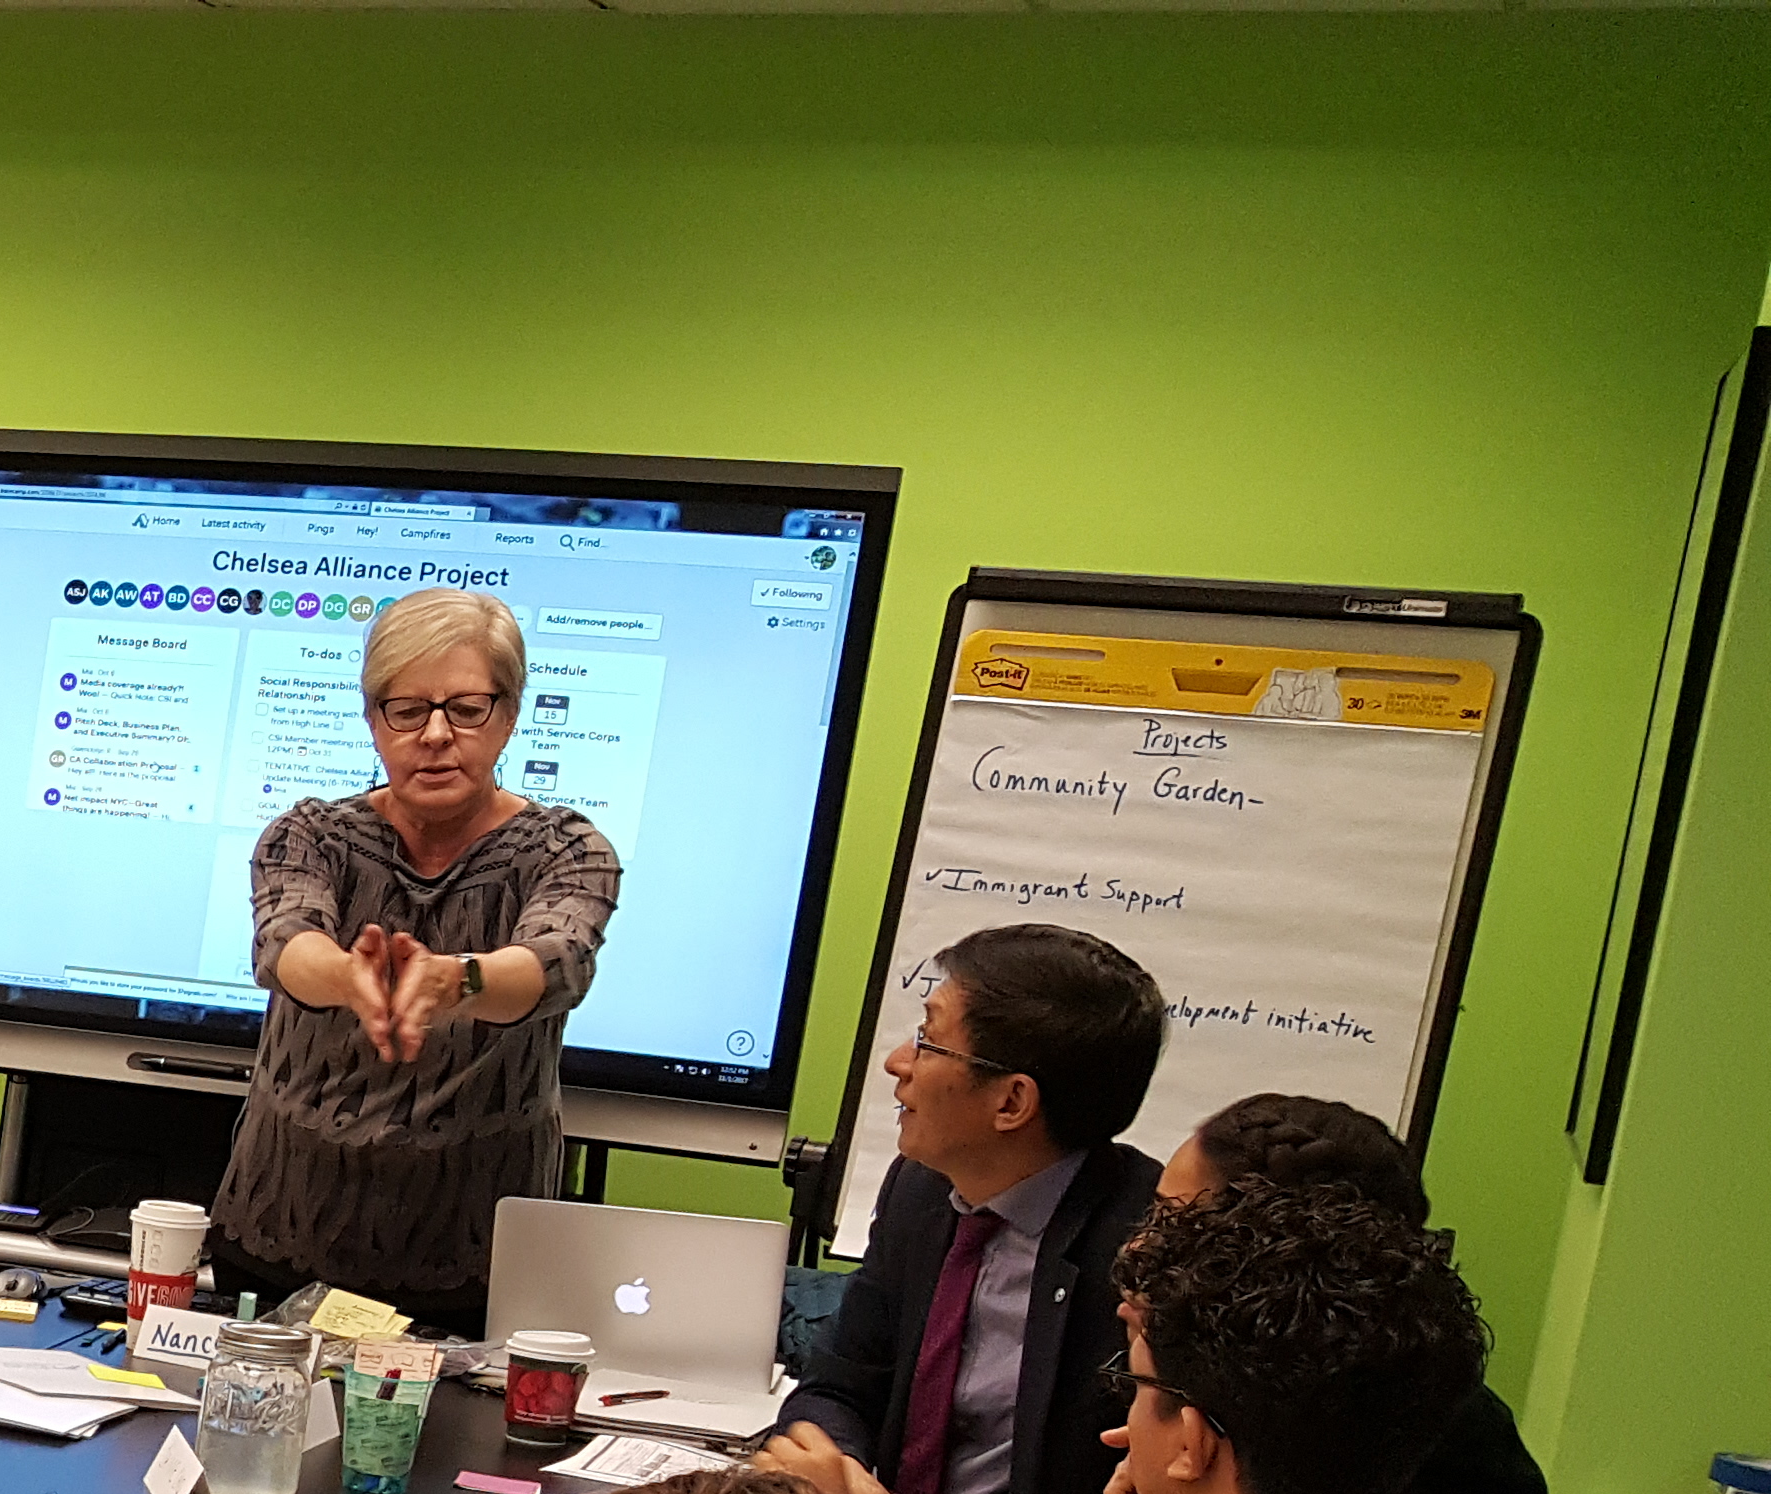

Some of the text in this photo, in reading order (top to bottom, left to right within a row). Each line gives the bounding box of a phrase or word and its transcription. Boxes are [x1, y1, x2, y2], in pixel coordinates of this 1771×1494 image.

[153, 516, 180, 526] Home
[202, 518, 266, 532] Latest activity
[308, 523, 334, 535] Pings
[357, 526, 378, 538] Hey!
[400, 528, 451, 541] Campfires
[495, 533, 534, 546] Reports
[212, 550, 509, 589] Chelsea Alliance Project
[67, 587, 86, 597] ASJ
[92, 589, 109, 599] AK
[116, 590, 137, 601] AW
[143, 592, 160, 601] AT
[168, 593, 186, 603] BD
[772, 588, 823, 601] Following
[194, 595, 211, 605] CC
[220, 596, 238, 606] CG
[272, 599, 290, 609] DC
[299, 601, 317, 611] DP
[324, 603, 344, 612] DG
[351, 604, 371, 614] GR
[546, 614, 607, 628] Add/remove
[782, 617, 825, 631] Settings
[98, 635, 187, 650] Message Board
[300, 647, 342, 660] To-dos
[529, 663, 587, 677] Schedule
[980, 668, 1023, 680] Post-it
[81, 679, 105, 687] Media
[108, 681, 144, 690] coverage
[260, 676, 290, 686] Social
[258, 690, 326, 702] Relationships
[1347, 698, 1364, 710] 30
[290, 707, 298, 715] up
[308, 709, 340, 719] meeting
[544, 711, 557, 719] 15
[123, 721, 159, 730] Business
[271, 718, 289, 726] from
[91, 729, 129, 738] Executive
[522, 726, 620, 743] with Service Corps
[1143, 718, 1228, 754] Projects
[285, 735, 318, 744] Member
[320, 737, 354, 748] meeting
[531, 740, 560, 750] Team
[84, 757, 138, 768] Collaboration
[316, 766, 348, 776] Chelsea
[263, 775, 291, 783] Update
[294, 776, 326, 787] Meeting
[533, 776, 546, 784] 29
[973, 746, 1127, 815] Community
[537, 794, 608, 808] Service Team
[63, 805, 87, 813] things
[942, 868, 1184, 913] Immigrant Support
[1266, 1008, 1377, 1044] initiative
[151, 1322, 219, 1353] Nanc
